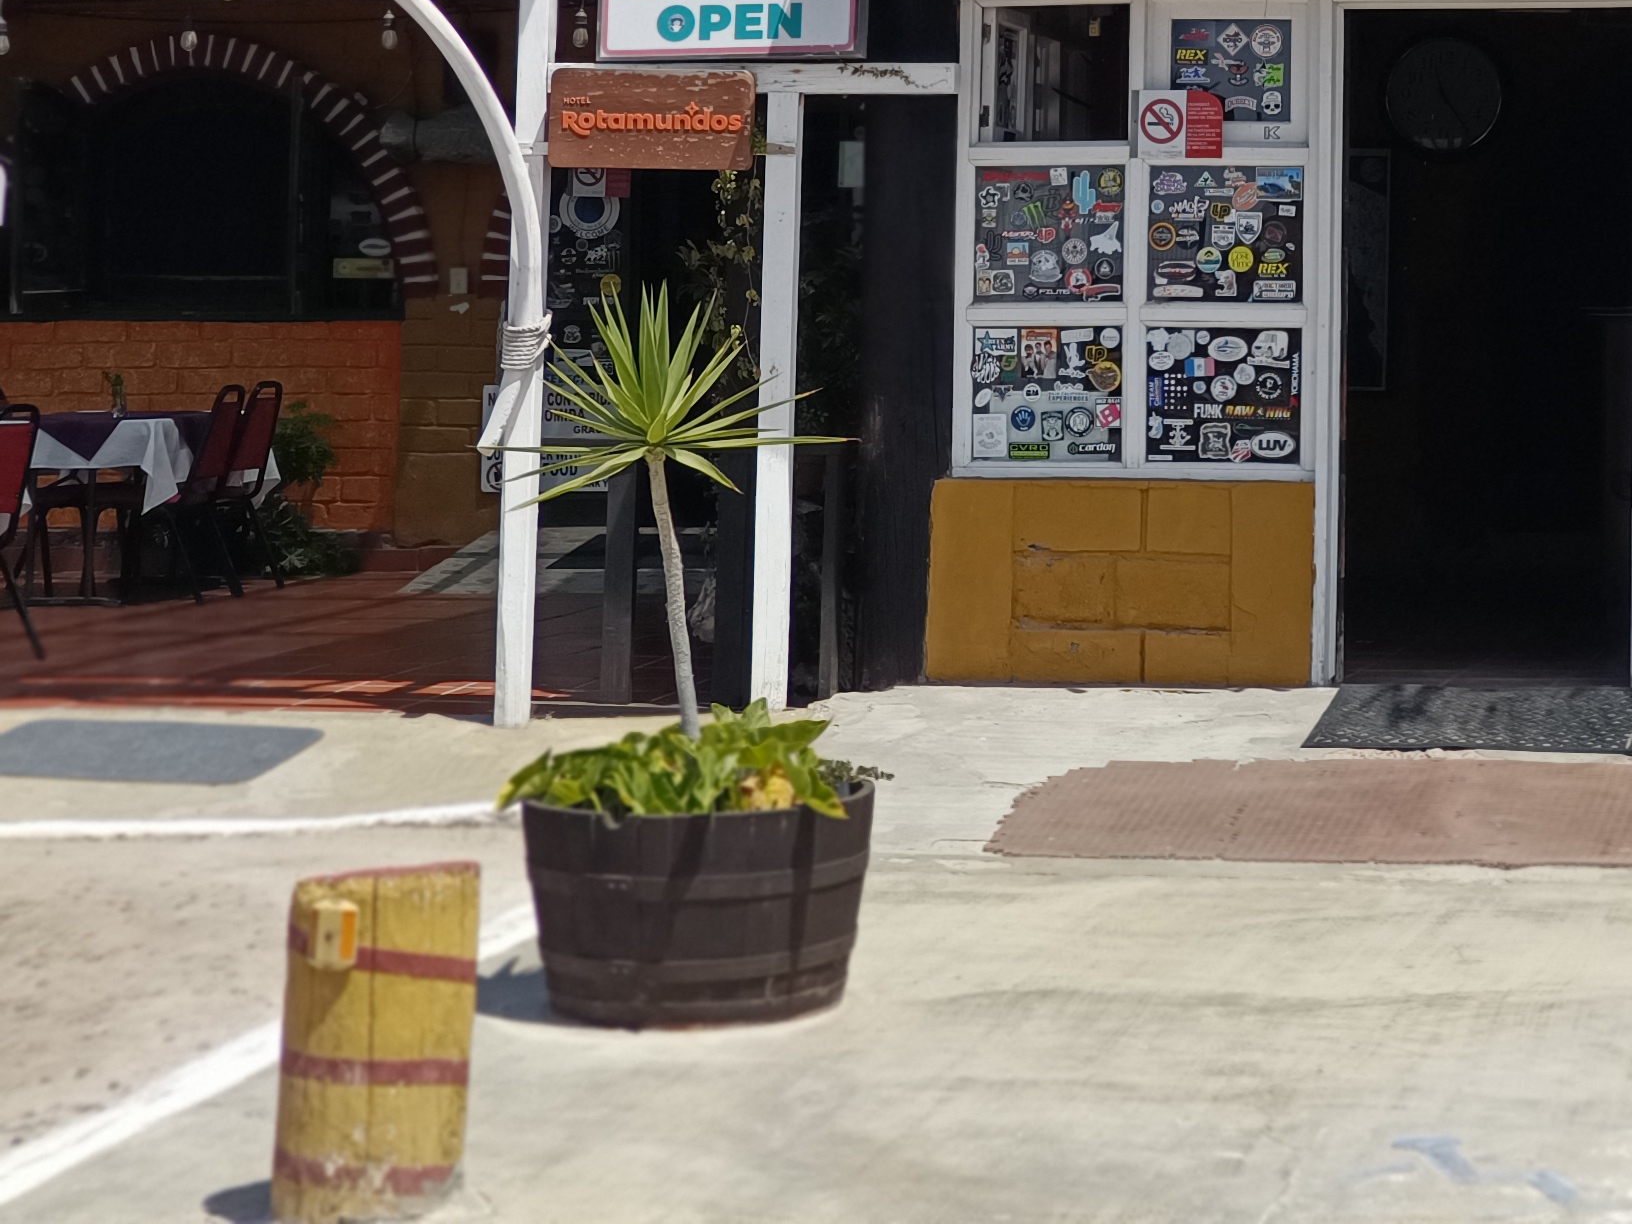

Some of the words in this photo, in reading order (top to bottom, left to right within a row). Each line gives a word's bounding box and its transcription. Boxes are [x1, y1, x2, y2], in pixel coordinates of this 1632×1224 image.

[657, 2, 803, 42] OPEN
[1176, 49, 1207, 61] REX
[563, 96, 592, 105] HOTEL
[562, 107, 743, 137] Rotamundos
[569, 224, 609, 239] WELCOME
[1258, 262, 1290, 275] REX
[1194, 403, 1223, 419] FUNK
[1225, 405, 1255, 417] RAW
[1258, 439, 1288, 451] LUV
